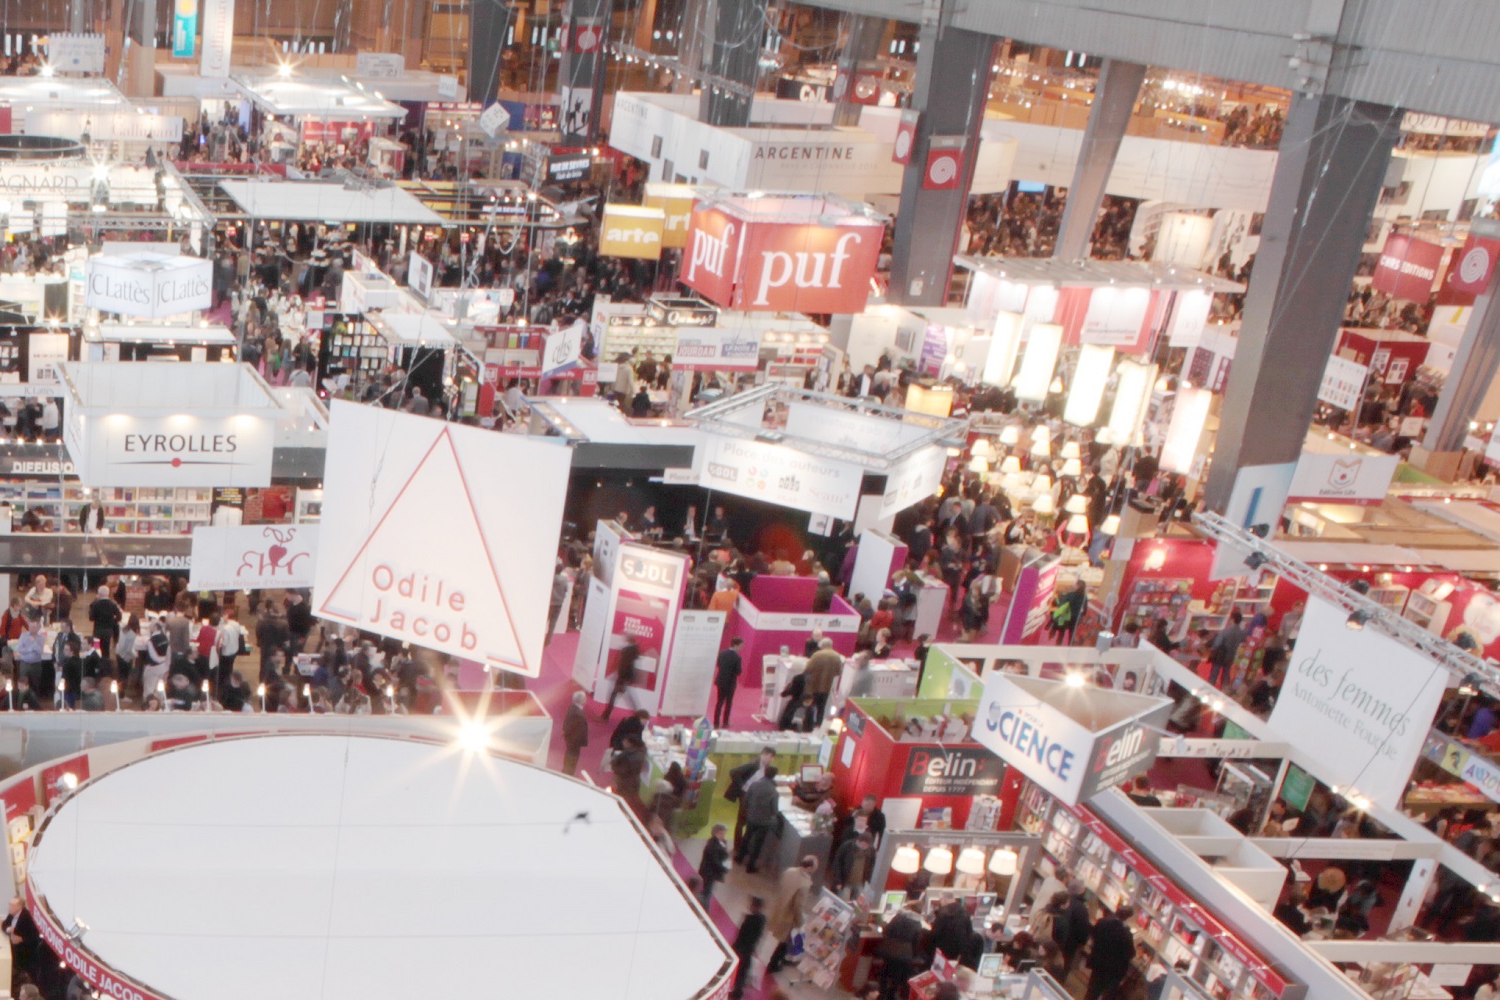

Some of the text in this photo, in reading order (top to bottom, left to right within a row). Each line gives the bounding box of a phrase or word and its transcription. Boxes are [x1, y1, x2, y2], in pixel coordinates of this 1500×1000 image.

[754, 146, 854, 160] ARGENTINE
[606, 225, 659, 244] arte
[687, 223, 733, 281] puf
[87, 273, 150, 305] JC Lattès
[752, 232, 861, 305] puf
[156, 278, 209, 306] JC Lattès
[677, 345, 715, 357] JOURDAN
[124, 434, 237, 453] EYROLLES
[12, 461, 77, 473] DIFFUSIO
[370, 564, 465, 612] Odile
[369, 599, 477, 651] Jacob
[1298, 648, 1333, 687] des
[1290, 681, 1352, 731] Antoinette
[1328, 667, 1410, 737] femmes
[985, 700, 1075, 783] SCIENCE
[1093, 724, 1144, 773] Belin
[1352, 719, 1398, 761] Fouque
[31, 904, 64, 954] EDITIONS
[64, 944, 97, 982] ODILE
